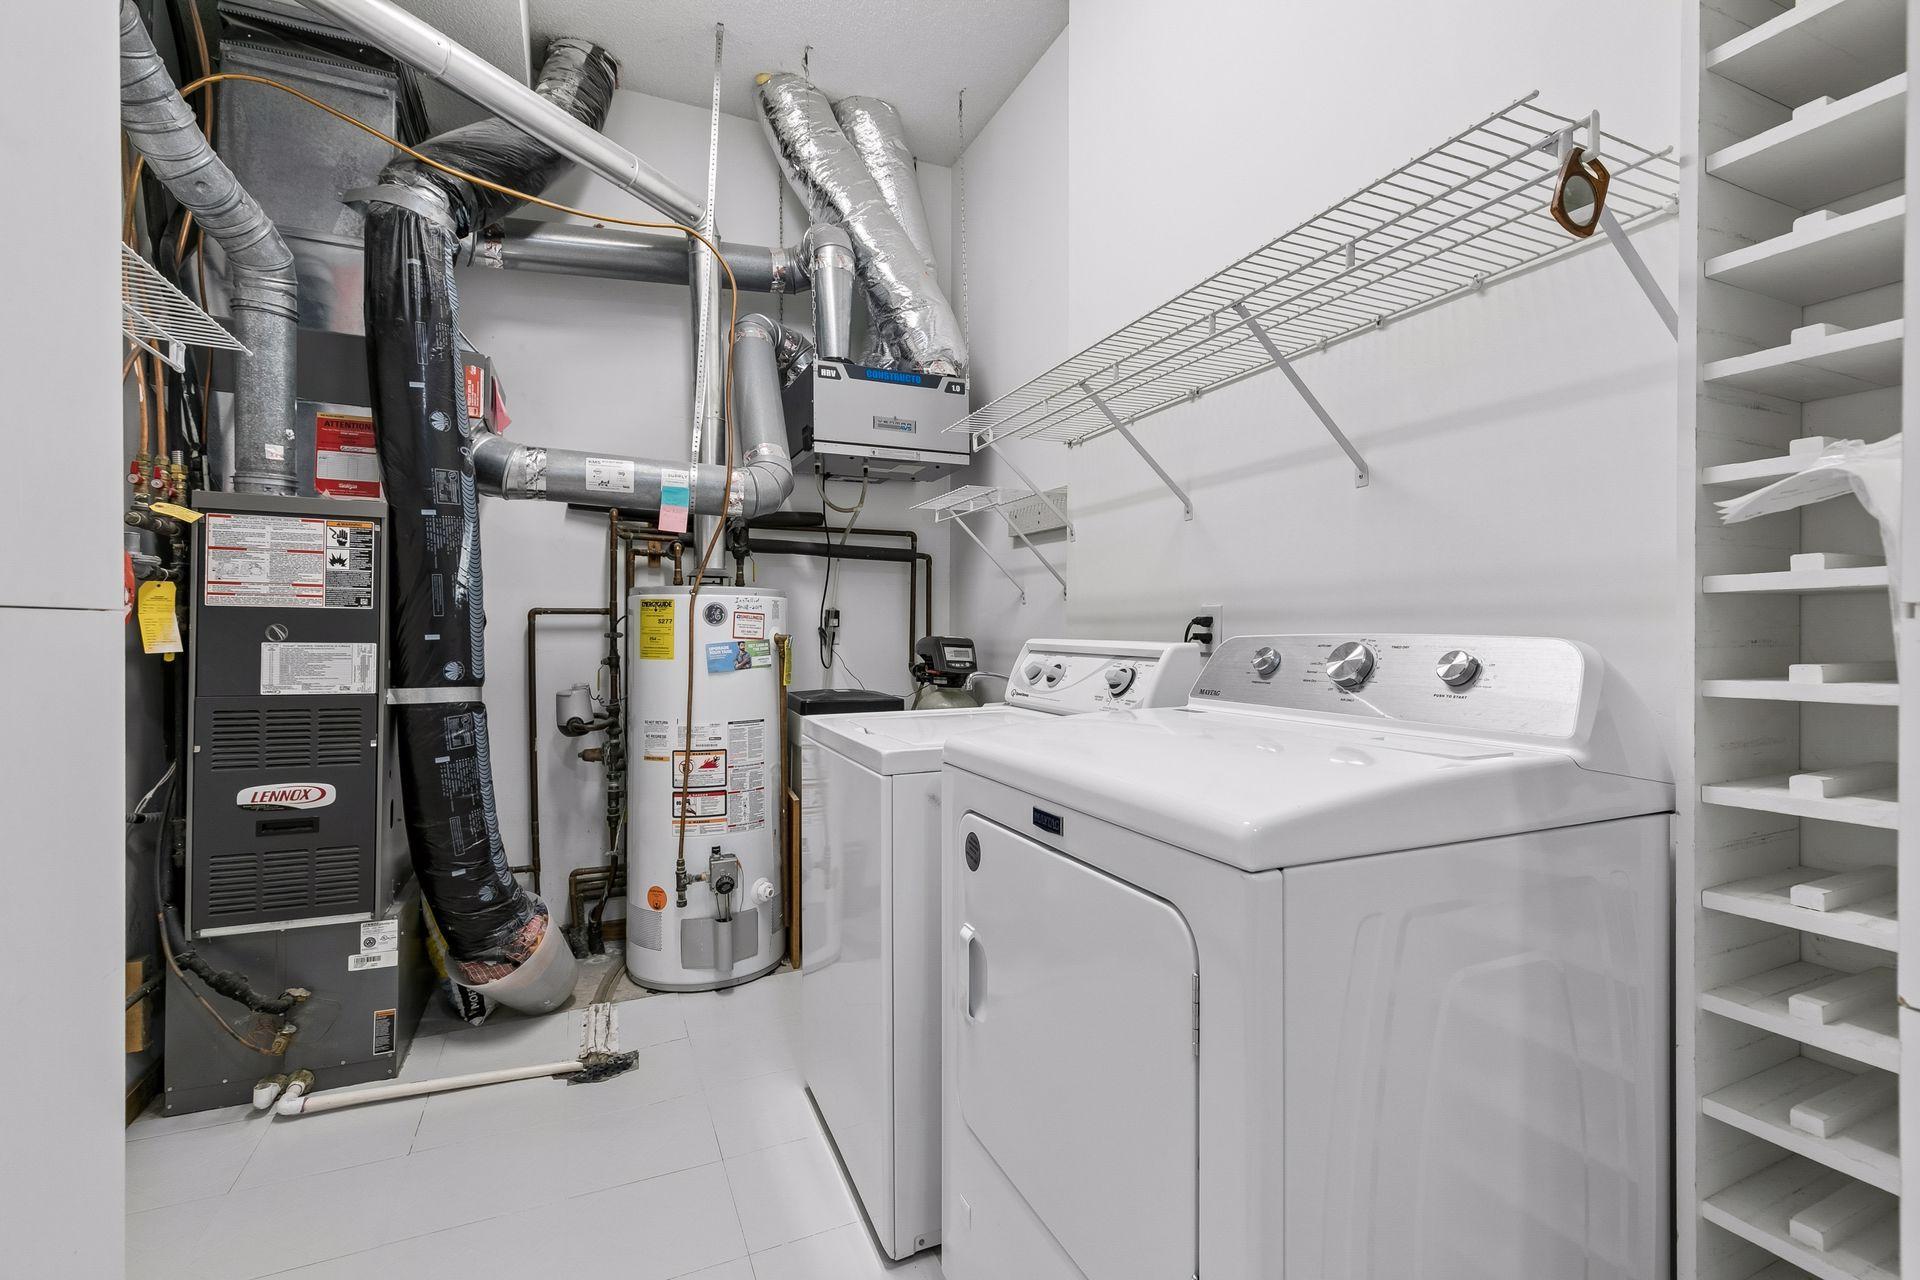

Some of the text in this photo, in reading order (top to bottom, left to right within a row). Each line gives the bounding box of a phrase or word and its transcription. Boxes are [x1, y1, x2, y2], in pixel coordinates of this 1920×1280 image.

[820, 368, 836, 378] HRV
[865, 369, 922, 384] CONSTRUCTO
[323, 420, 372, 430] ATTENTION
[1198, 688, 1222, 697] MAYTAG
[250, 788, 313, 804] LENNOX
